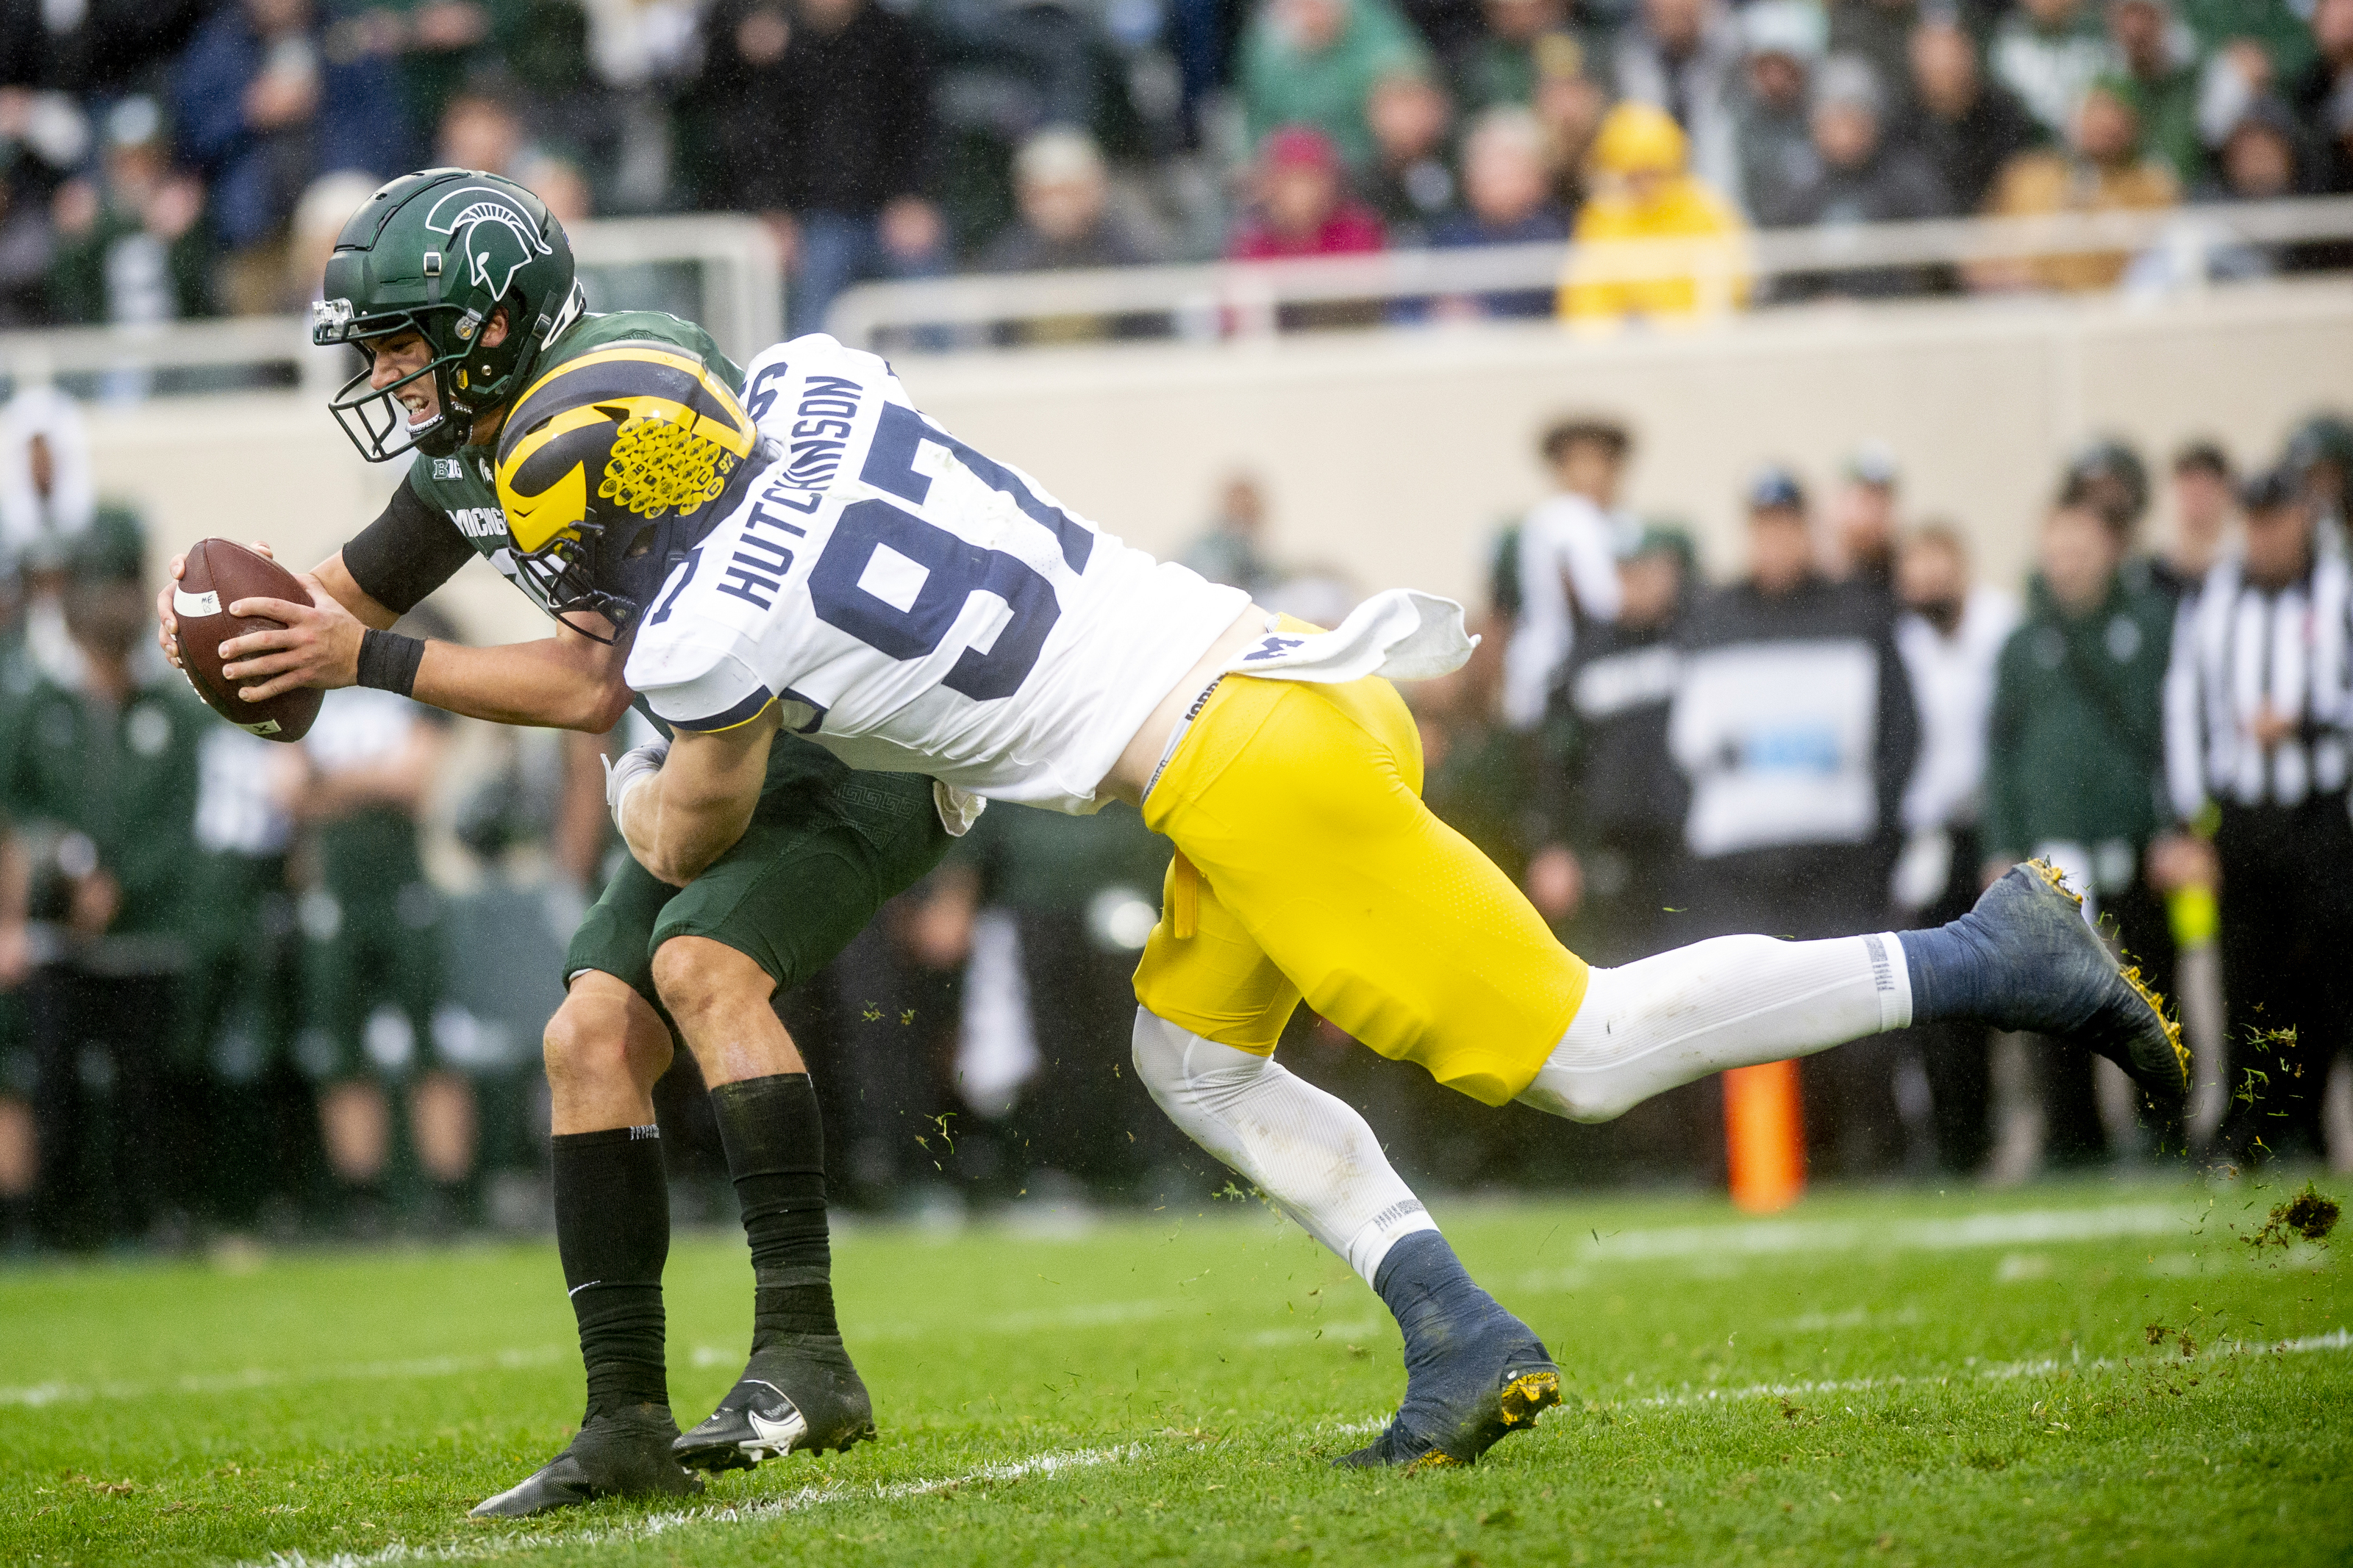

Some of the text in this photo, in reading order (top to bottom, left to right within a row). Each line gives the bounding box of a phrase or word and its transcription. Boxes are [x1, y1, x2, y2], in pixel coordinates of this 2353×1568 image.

[716, 376, 864, 612] HUTCHINSON
[718, 451, 735, 474] 97
[807, 401, 1093, 701] 97
